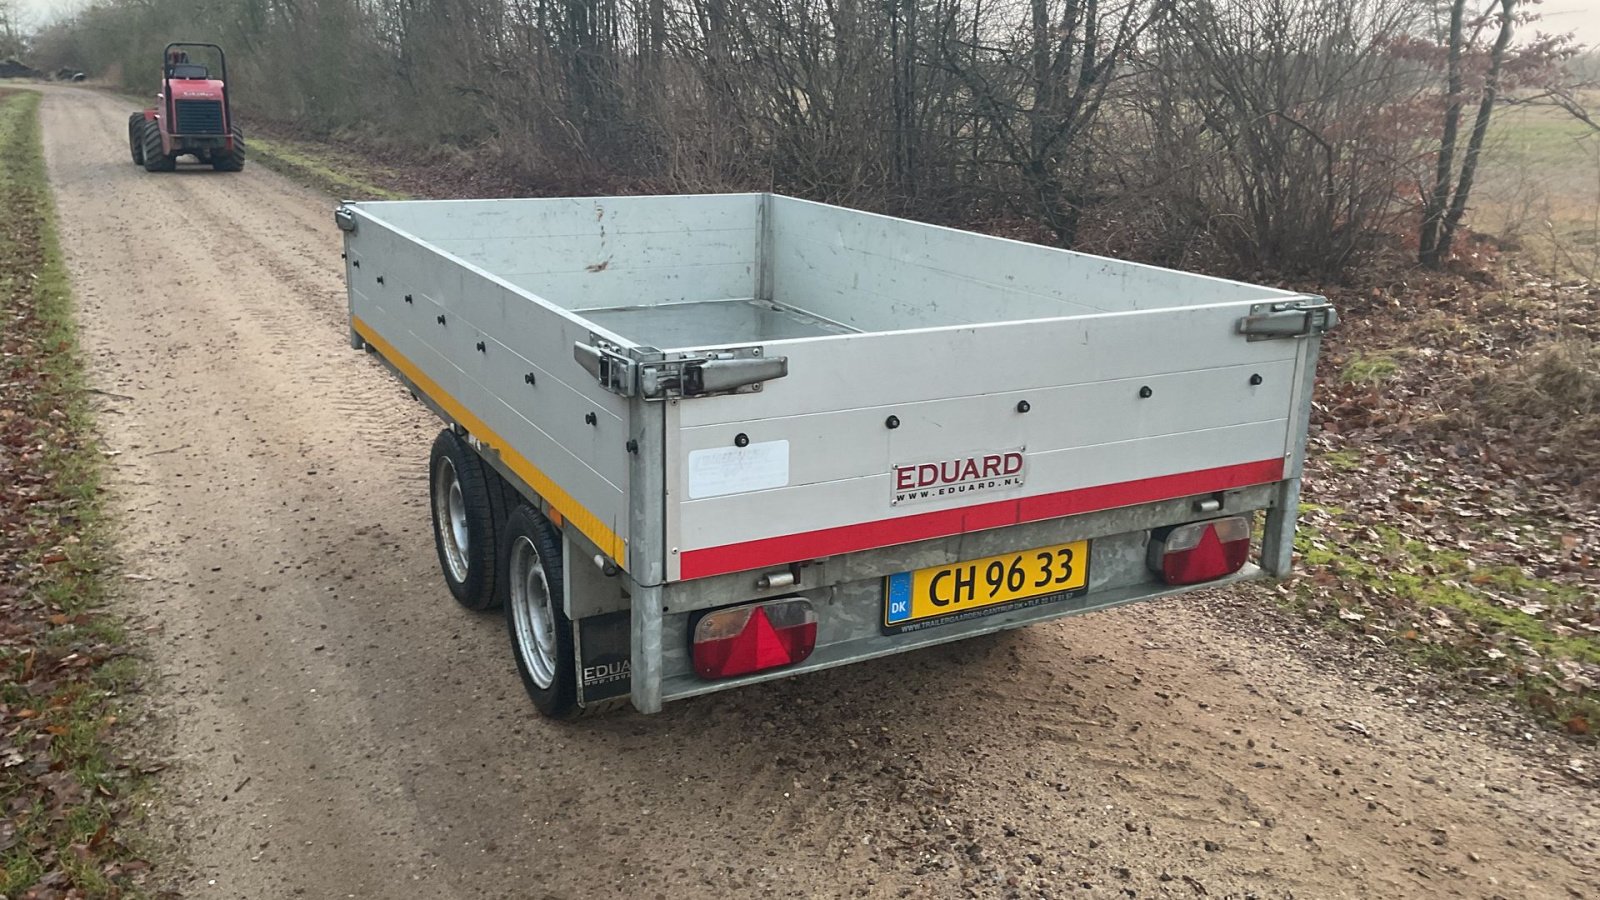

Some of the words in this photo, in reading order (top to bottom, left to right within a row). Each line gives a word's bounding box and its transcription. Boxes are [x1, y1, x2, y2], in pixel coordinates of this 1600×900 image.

[896, 452, 1023, 490] EDUARD
[896, 478, 1020, 502] WWW.EDUARD.NL
[929, 565, 976, 607] CH
[985, 555, 1026, 598] 96
[1034, 548, 1073, 588] 33
[891, 600, 907, 614] DK
[584, 659, 631, 680] EDUA
